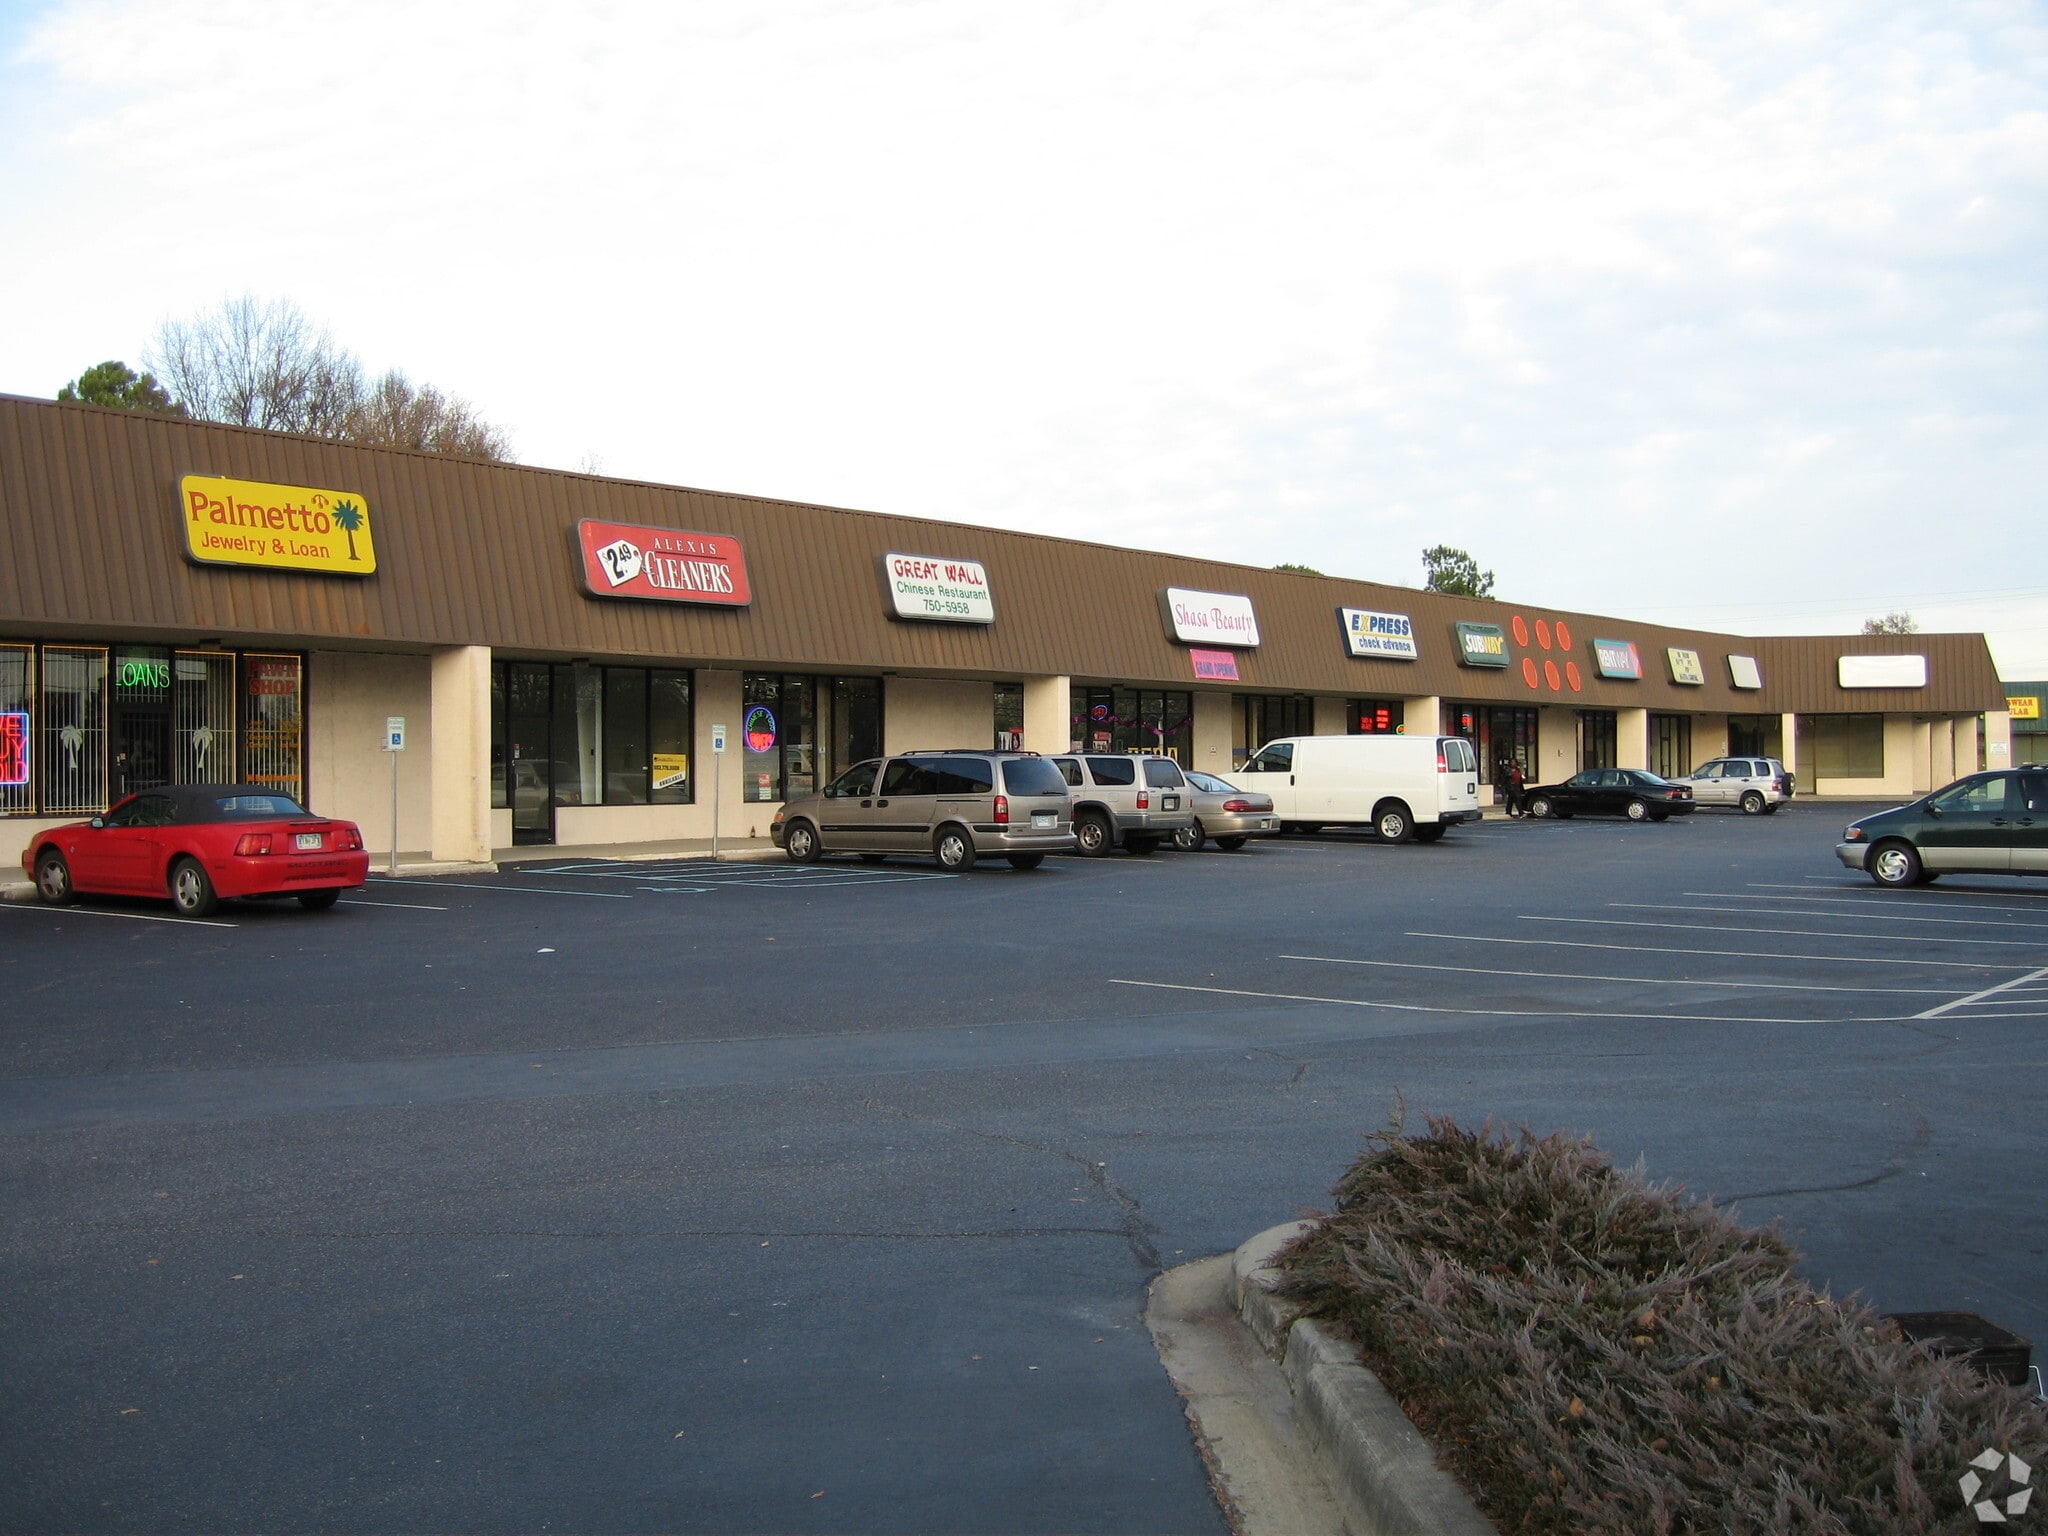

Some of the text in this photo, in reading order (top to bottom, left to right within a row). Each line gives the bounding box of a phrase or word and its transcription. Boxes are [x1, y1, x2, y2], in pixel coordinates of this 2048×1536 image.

[188, 491, 331, 534] Palmetto
[201, 532, 331, 558] Jewelry & Loan
[654, 538, 717, 554] ALEXIS
[644, 551, 734, 594] CLEANERS
[894, 560, 983, 585] GREAT WALL
[897, 581, 988, 600] Chinese Restaurant
[923, 599, 970, 614] 750-5958
[1175, 603, 1253, 643] Shasa Beauty
[1352, 614, 1409, 636] EXPRESS
[1359, 635, 1411, 652] check advance
[1465, 634, 1504, 655] SUBWAY
[115, 662, 170, 688] OANS
[249, 678, 298, 695] SHOP
[0, 715, 21, 737] E
[0, 737, 27, 759] UY
